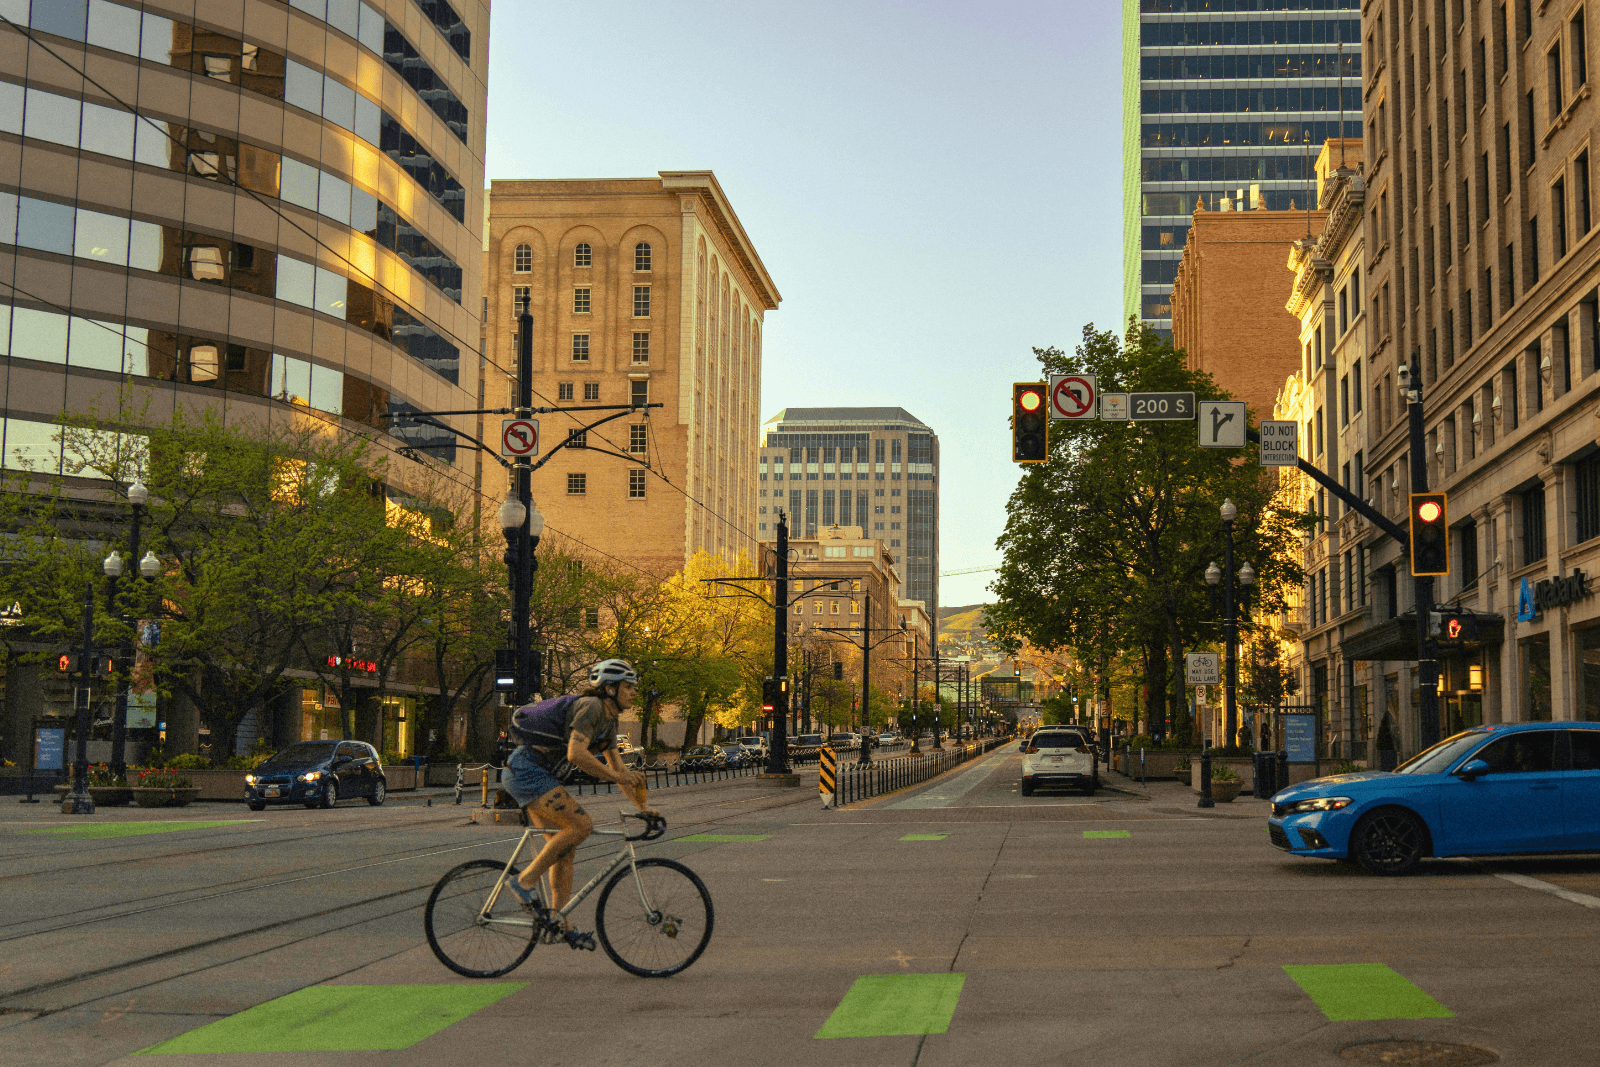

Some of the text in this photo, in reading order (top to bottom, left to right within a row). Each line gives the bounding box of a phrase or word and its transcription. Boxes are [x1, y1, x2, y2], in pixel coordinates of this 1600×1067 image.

[1136, 399, 1169, 414] 200
[1263, 425, 1294, 436] DO NOT
[1263, 440, 1294, 451] BLOCK
[1262, 453, 1295, 461] INTERSECTION
